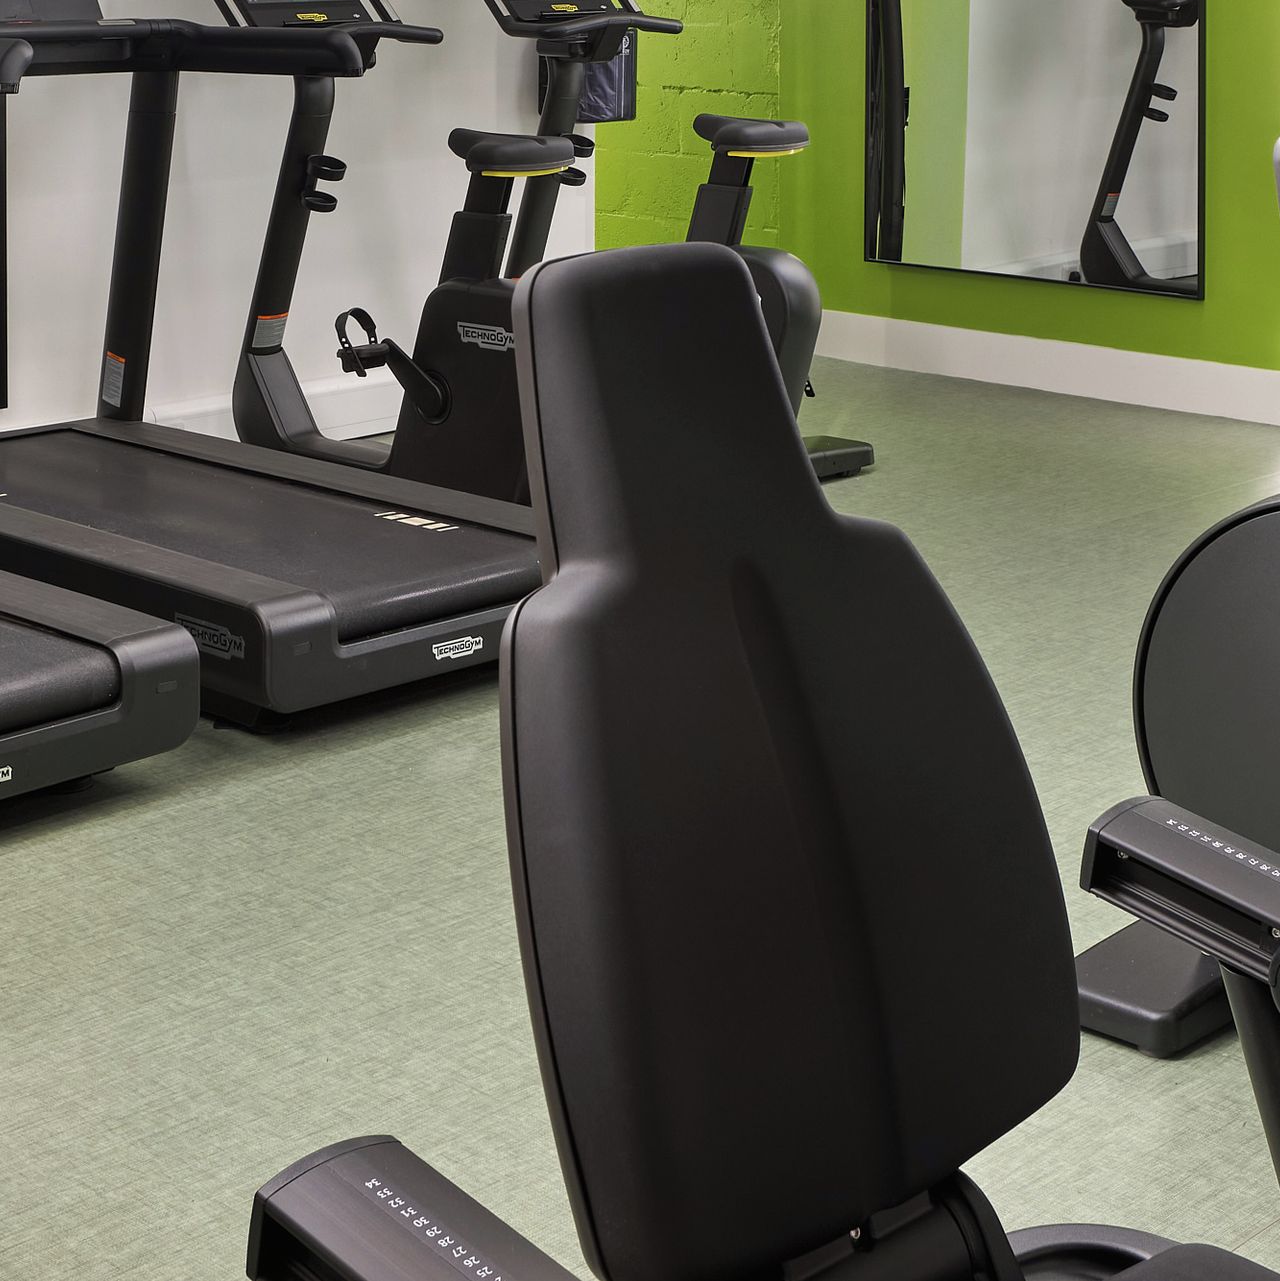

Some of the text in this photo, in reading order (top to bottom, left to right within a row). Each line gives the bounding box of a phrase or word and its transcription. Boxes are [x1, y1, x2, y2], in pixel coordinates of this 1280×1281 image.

[364, 1178, 381, 1189] 34
[376, 1187, 393, 1198] 33
[388, 1197, 405, 1208] 32
[400, 1207, 417, 1218] 31
[412, 1216, 430, 1227] 30
[425, 1226, 442, 1238] 29
[437, 1236, 455, 1247] 28
[452, 1246, 467, 1258] 27
[463, 1256, 480, 1267] 26
[476, 1266, 493, 1278] 25
